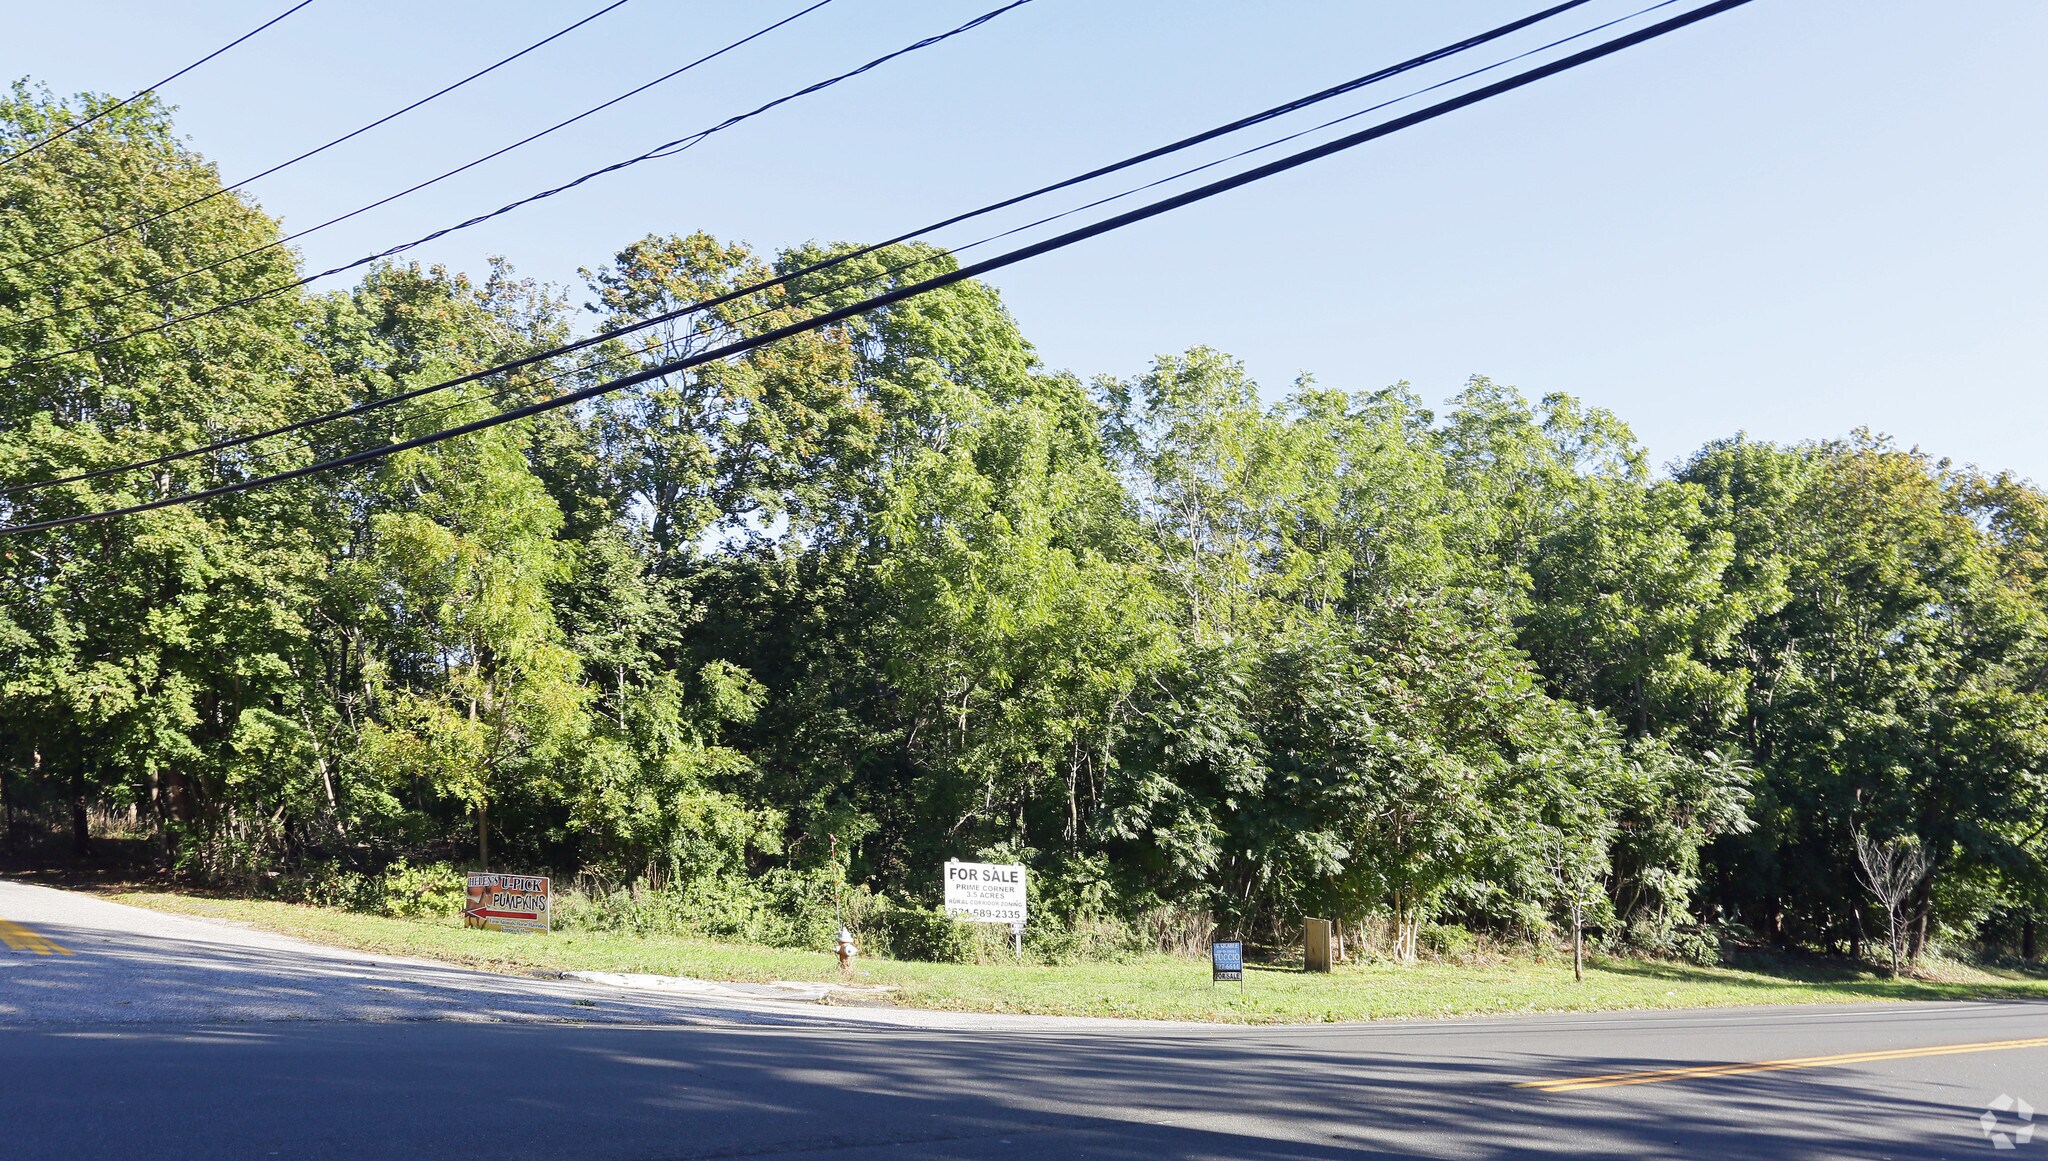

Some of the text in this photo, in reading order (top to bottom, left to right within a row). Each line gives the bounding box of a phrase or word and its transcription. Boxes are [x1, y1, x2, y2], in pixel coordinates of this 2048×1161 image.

[950, 868, 1018, 883] FOR SALE
[501, 877, 542, 892] U-PICK
[982, 885, 1015, 893] CORNER
[493, 893, 546, 911] PUMPKINS
